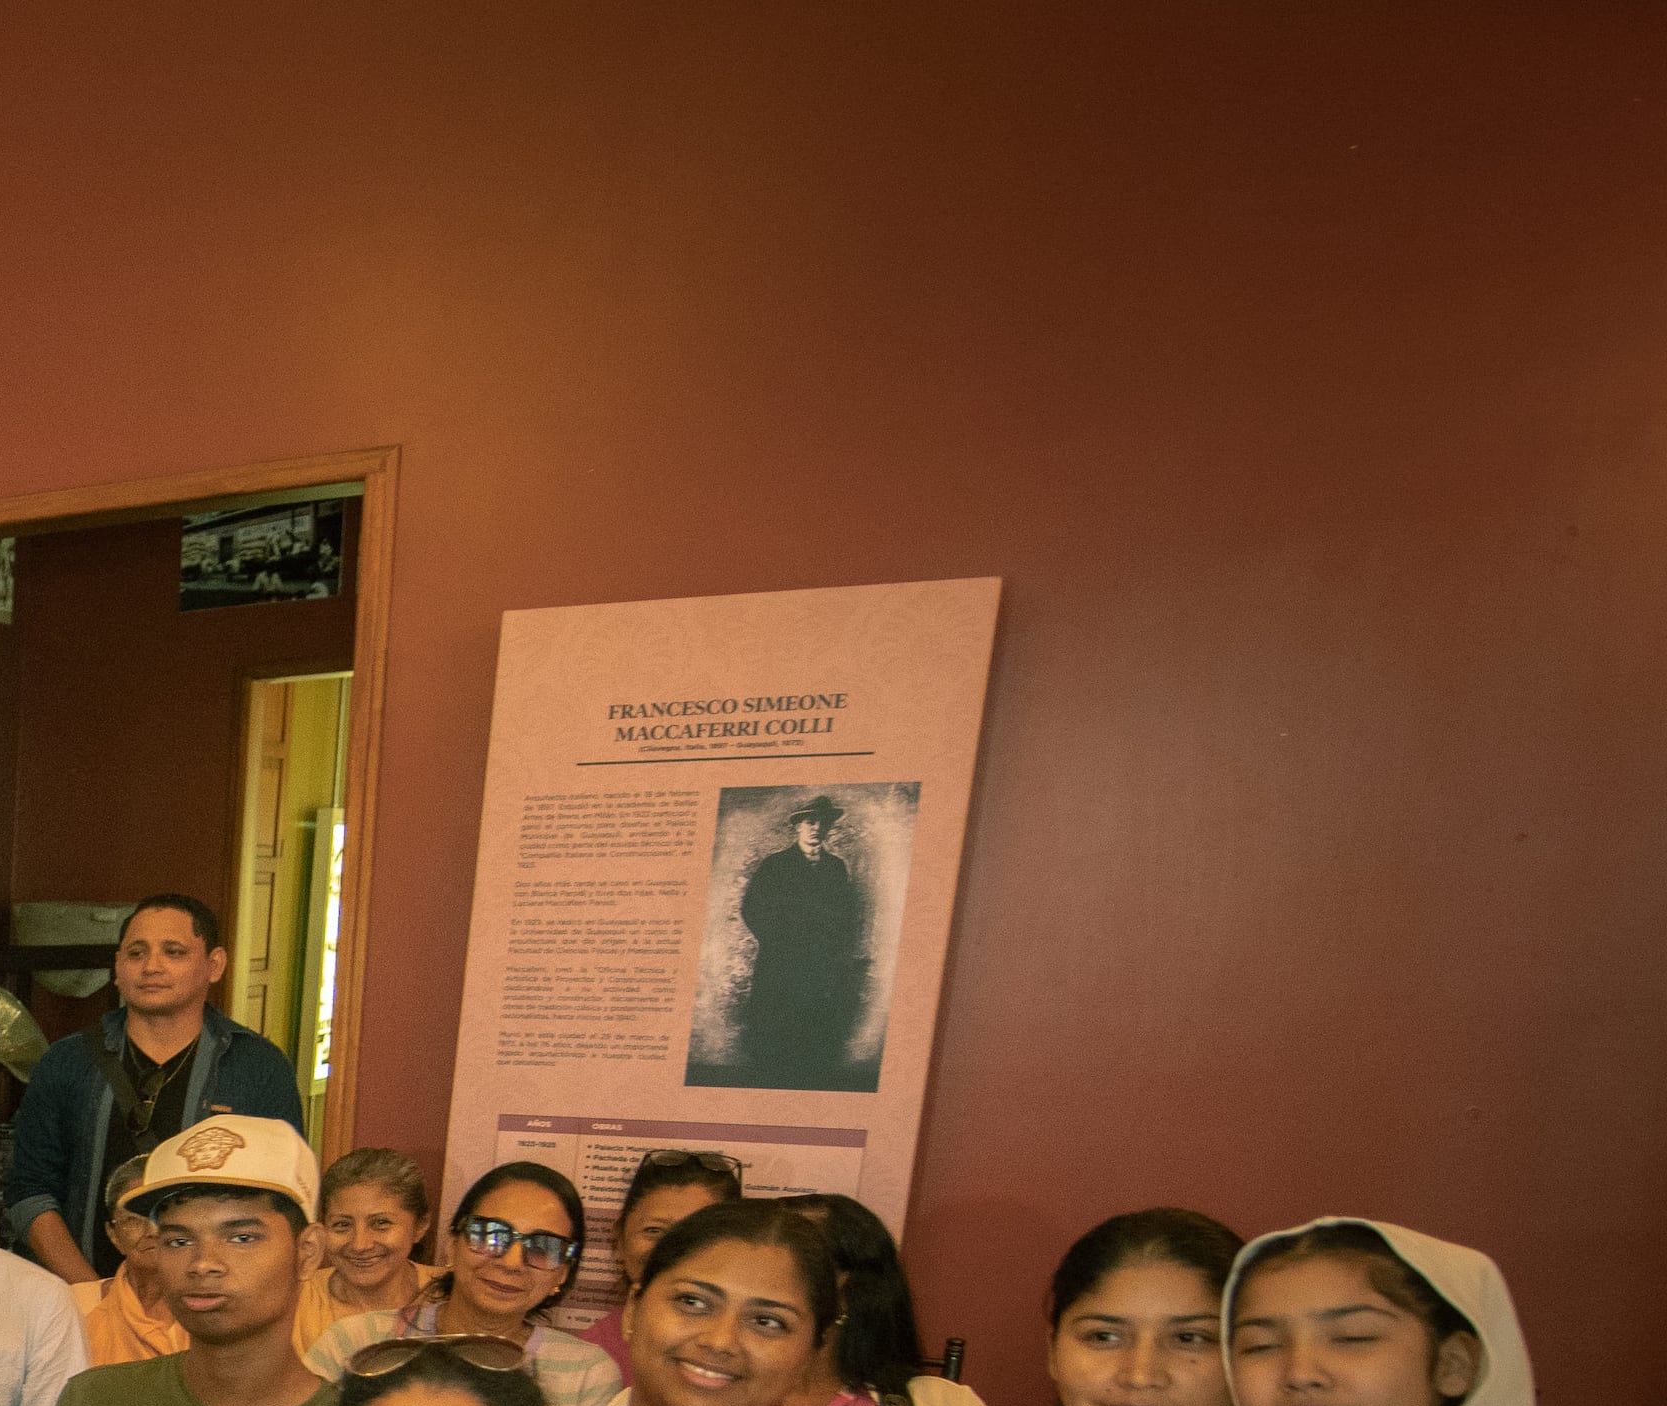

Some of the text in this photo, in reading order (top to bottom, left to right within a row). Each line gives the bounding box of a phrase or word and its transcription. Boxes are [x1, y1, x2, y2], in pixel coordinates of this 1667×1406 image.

[608, 693, 848, 720] FRANCESCO SIMEONE
[614, 717, 835, 742] MACCAFERRI COLLI
